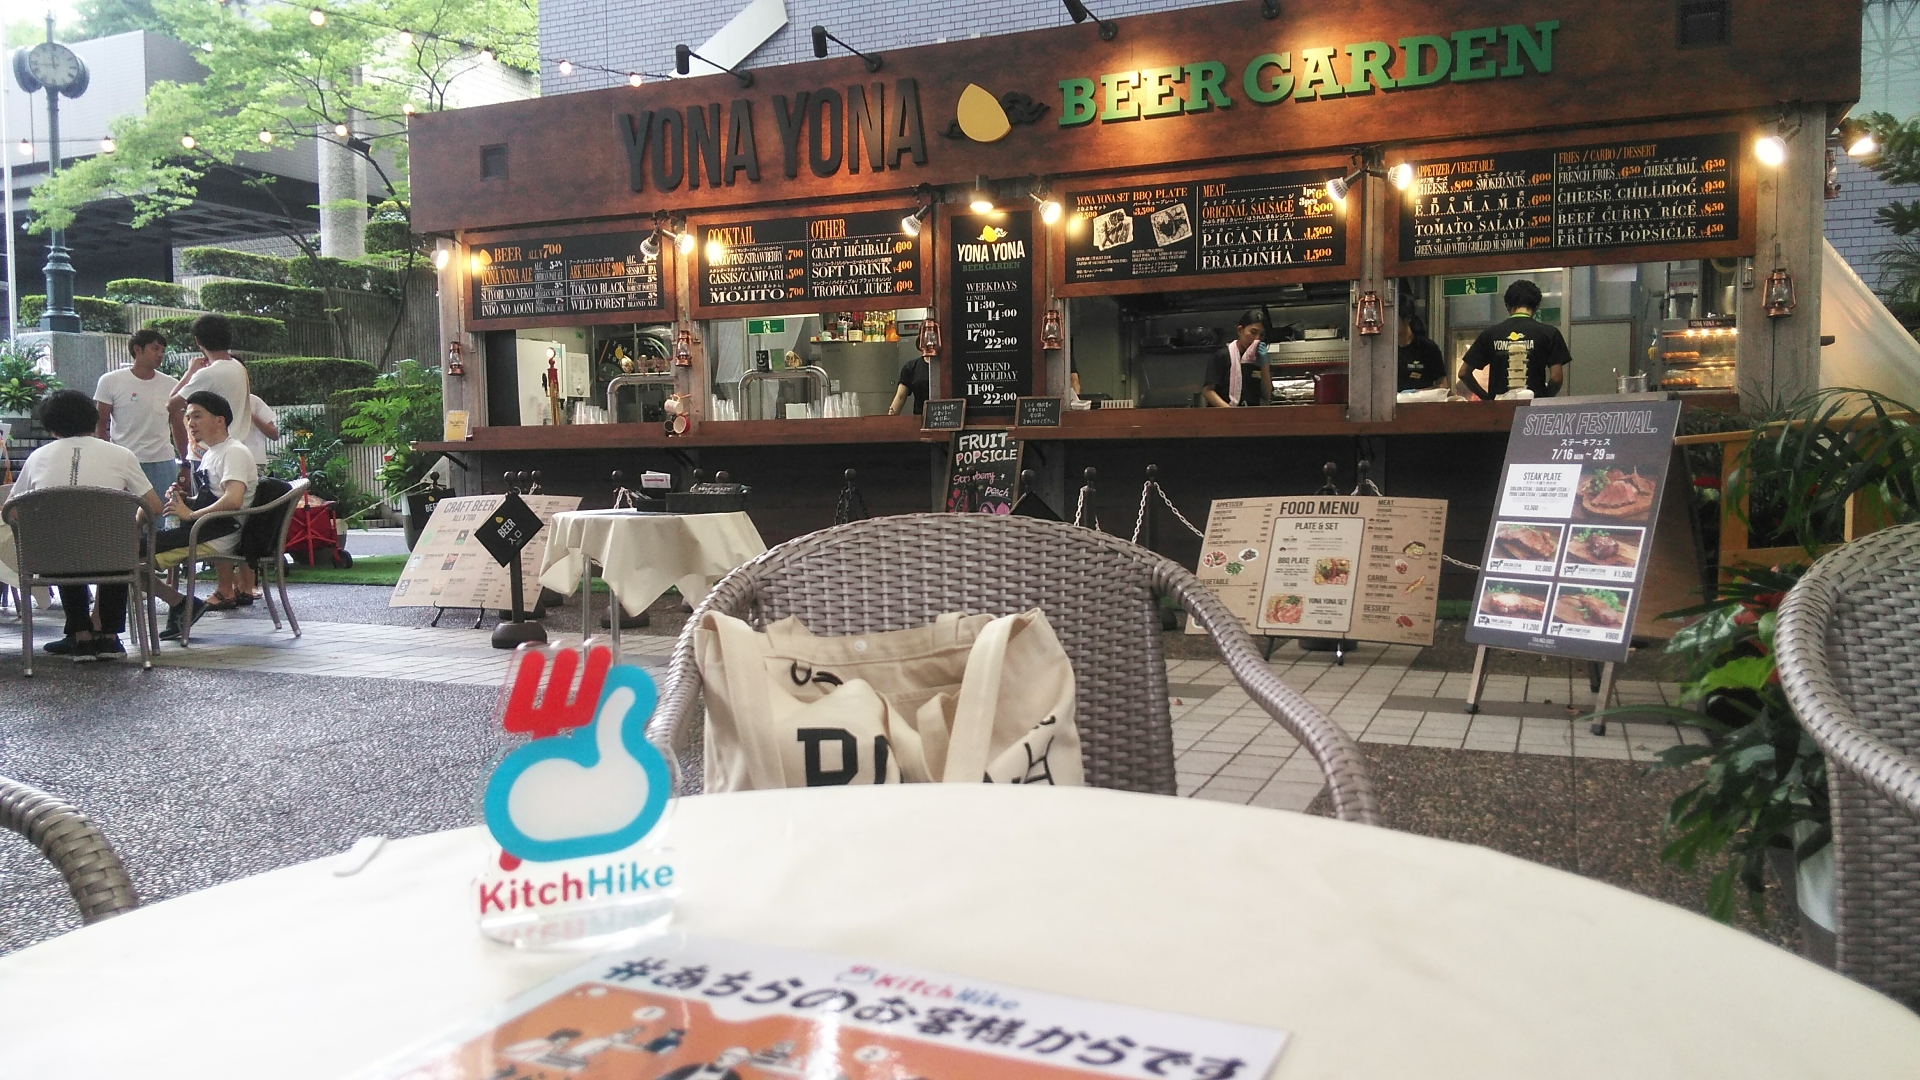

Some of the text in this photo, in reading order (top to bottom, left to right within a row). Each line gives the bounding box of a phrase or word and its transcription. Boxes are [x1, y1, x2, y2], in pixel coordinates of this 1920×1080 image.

[1058, 20, 1560, 126] BEER GARDEN
[619, 77, 928, 193] YONA YONA
[1558, 152, 1580, 164] FRIES
[1623, 144, 1658, 158] DESSERT
[1558, 171, 1590, 184] FRENCH
[1592, 169, 1616, 181] FRIES
[1643, 164, 1675, 177] CHEESE
[1676, 161, 1699, 175] BALL
[1202, 183, 1226, 198] MEAT
[1475, 177, 1506, 191] SMOKED
[1506, 174, 1526, 189] NUTS
[1076, 187, 1188, 206] YONA YONA SET BBQ PLATE
[1557, 188, 1612, 204] CHEESE
[1617, 182, 1697, 200] CHILLIDOG
[1202, 199, 1295, 220] ORIGINAL SAUSAGE
[1415, 196, 1525, 216] EDAMAME
[1557, 210, 1596, 226] BEEF
[1601, 205, 1654, 222] CURRY
[1660, 203, 1697, 218] RICE
[811, 218, 846, 240] OTHER
[1415, 221, 1473, 237] TOMATO
[1479, 217, 1525, 231] SALAD
[708, 226, 756, 246] COCKTAIL
[1203, 227, 1294, 247] PICANHA
[1557, 231, 1613, 247] FRUITS
[1620, 225, 1697, 242] POPSICLE
[494, 246, 522, 263] BEER
[811, 246, 842, 260] CRAFT
[844, 242, 893, 258] HIGHBALL
[957, 240, 1026, 263] YONA YONA
[1452, 241, 1468, 253] WITH
[962, 261, 1021, 272] BEER GARDEN
[1202, 250, 1293, 269] FRALDINHA
[481, 270, 500, 285] YONA
[500, 269, 520, 284] YONA
[521, 267, 533, 282] ALE
[570, 264, 582, 279] ARK
[582, 263, 600, 279] HILLS
[600, 262, 611, 277] ALE
[811, 265, 845, 279] SOFT
[849, 262, 892, 277] DRINK
[506, 288, 515, 300] NO
[516, 287, 534, 299] NEKO
[570, 283, 597, 296] TOKYO
[600, 281, 626, 294] BLACK
[811, 281, 893, 298] TROPICAL JUICE
[966, 281, 1018, 292] WEEKDAYS
[571, 298, 593, 311] WILD
[595, 297, 626, 309] FOREST
[627, 299, 658, 308] BLOND ALE
[710, 288, 785, 303] MOJITO
[482, 304, 499, 317] INDO
[501, 303, 511, 315] NO
[966, 300, 996, 313] 11:30
[987, 308, 1018, 322] 14:00
[966, 328, 996, 342] 17:00
[984, 337, 1018, 350] 22:00
[967, 362, 1011, 373] WEEKEND
[980, 370, 1019, 382] HOLIDAY
[967, 383, 995, 396] 11:00
[982, 392, 1018, 406] 22:00
[1523, 412, 1577, 436] STEAK
[958, 432, 1009, 451] FRUIT
[1560, 438, 1611, 447] ステーキフェス
[955, 449, 1018, 466] POPSICLE
[1551, 448, 1574, 460] 7/16
[1592, 448, 1606, 460] 29
[1523, 472, 1562, 481] STEAK PLATE
[444, 500, 473, 514] CRAFT
[1279, 501, 1315, 515] FOOD
[1318, 501, 1360, 515] MENU
[497, 518, 517, 539] BEER
[1295, 522, 1339, 530] PLATE SET
[508, 529, 523, 546] 入口
[1291, 556, 1311, 564] PLATE
[1363, 604, 1391, 613] DESSERT
[479, 861, 674, 915] KitchHike
[874, 973, 1020, 1011] KitchHike
